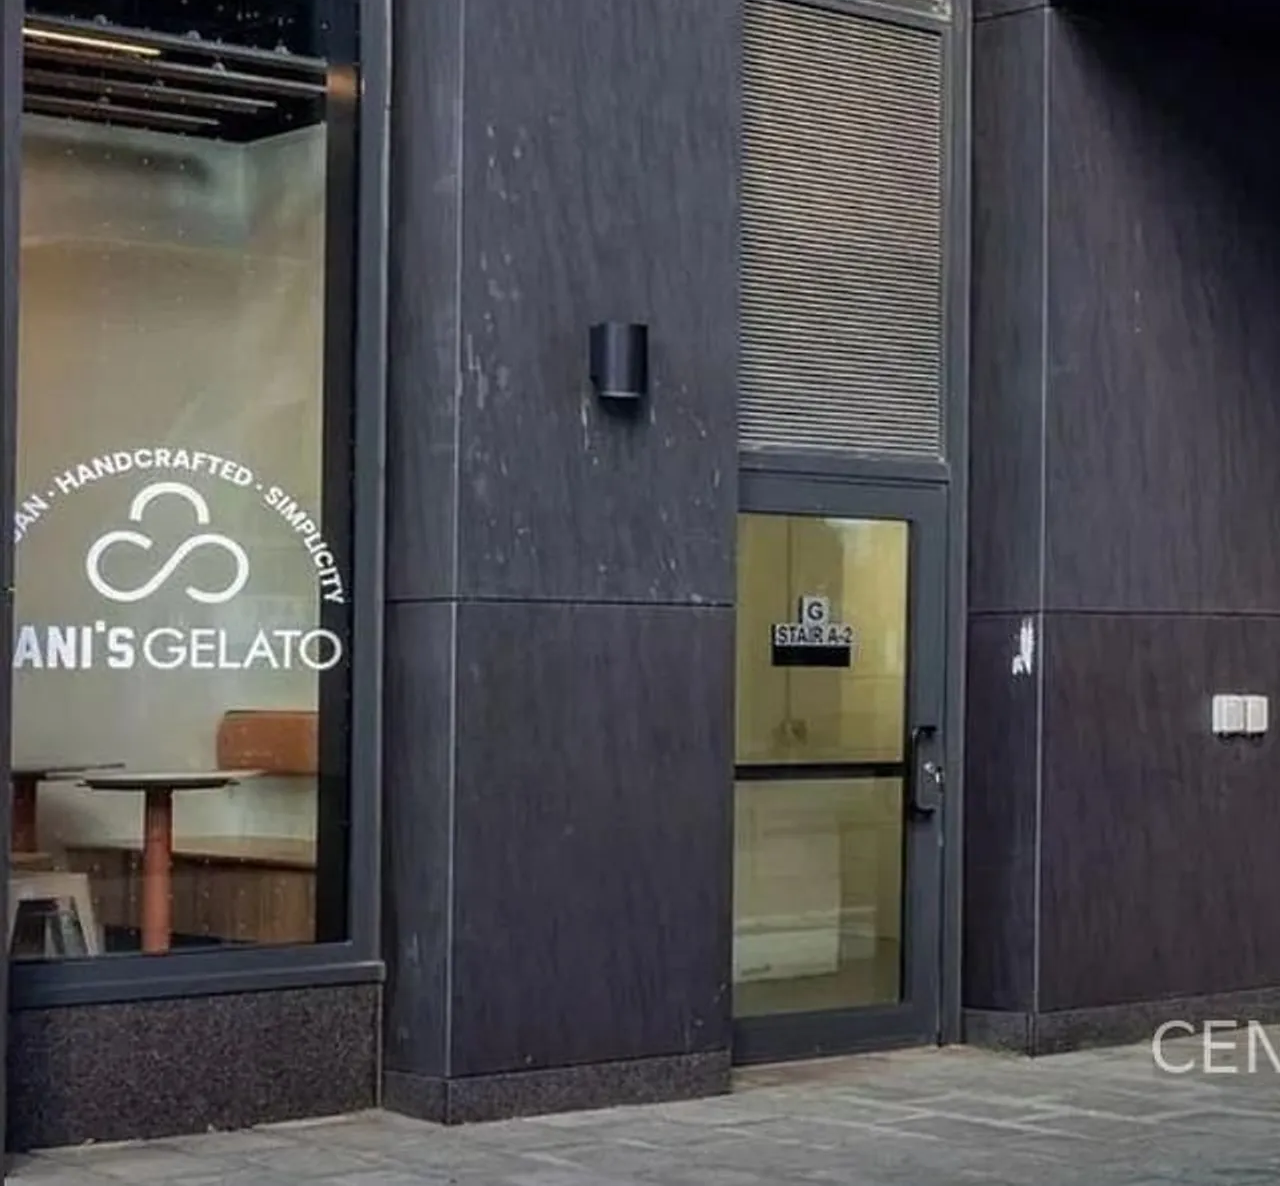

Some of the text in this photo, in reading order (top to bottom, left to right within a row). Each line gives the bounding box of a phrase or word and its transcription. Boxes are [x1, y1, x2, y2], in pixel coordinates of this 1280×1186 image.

[54, 447, 254, 493] HANDCRAFTED
[264, 486, 345, 604] SIMPLICITY
[807, 600, 824, 620] G
[12, 620, 342, 670] ANI'S GELATO
